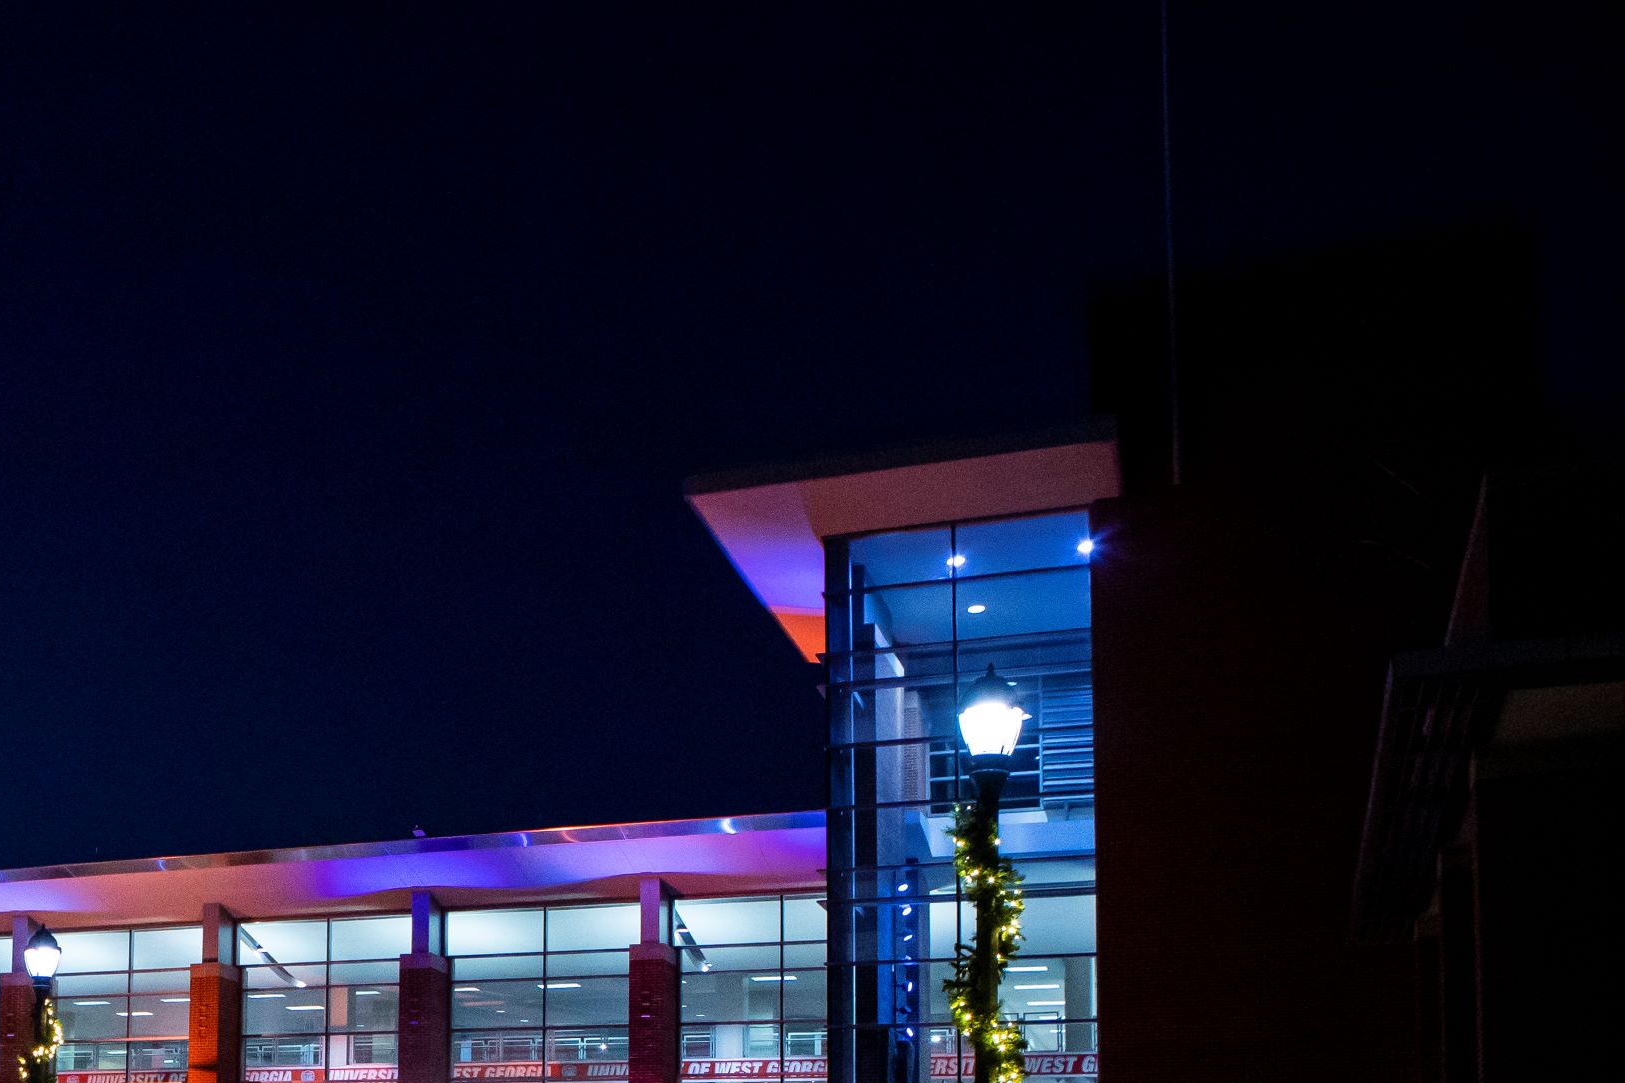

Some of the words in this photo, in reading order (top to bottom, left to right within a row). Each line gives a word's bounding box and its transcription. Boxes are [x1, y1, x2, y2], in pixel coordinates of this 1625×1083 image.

[453, 1066, 481, 1078] EST
[687, 1061, 711, 1075] OF
[714, 1061, 764, 1074] WEST
[766, 1060, 826, 1073] GEORG
